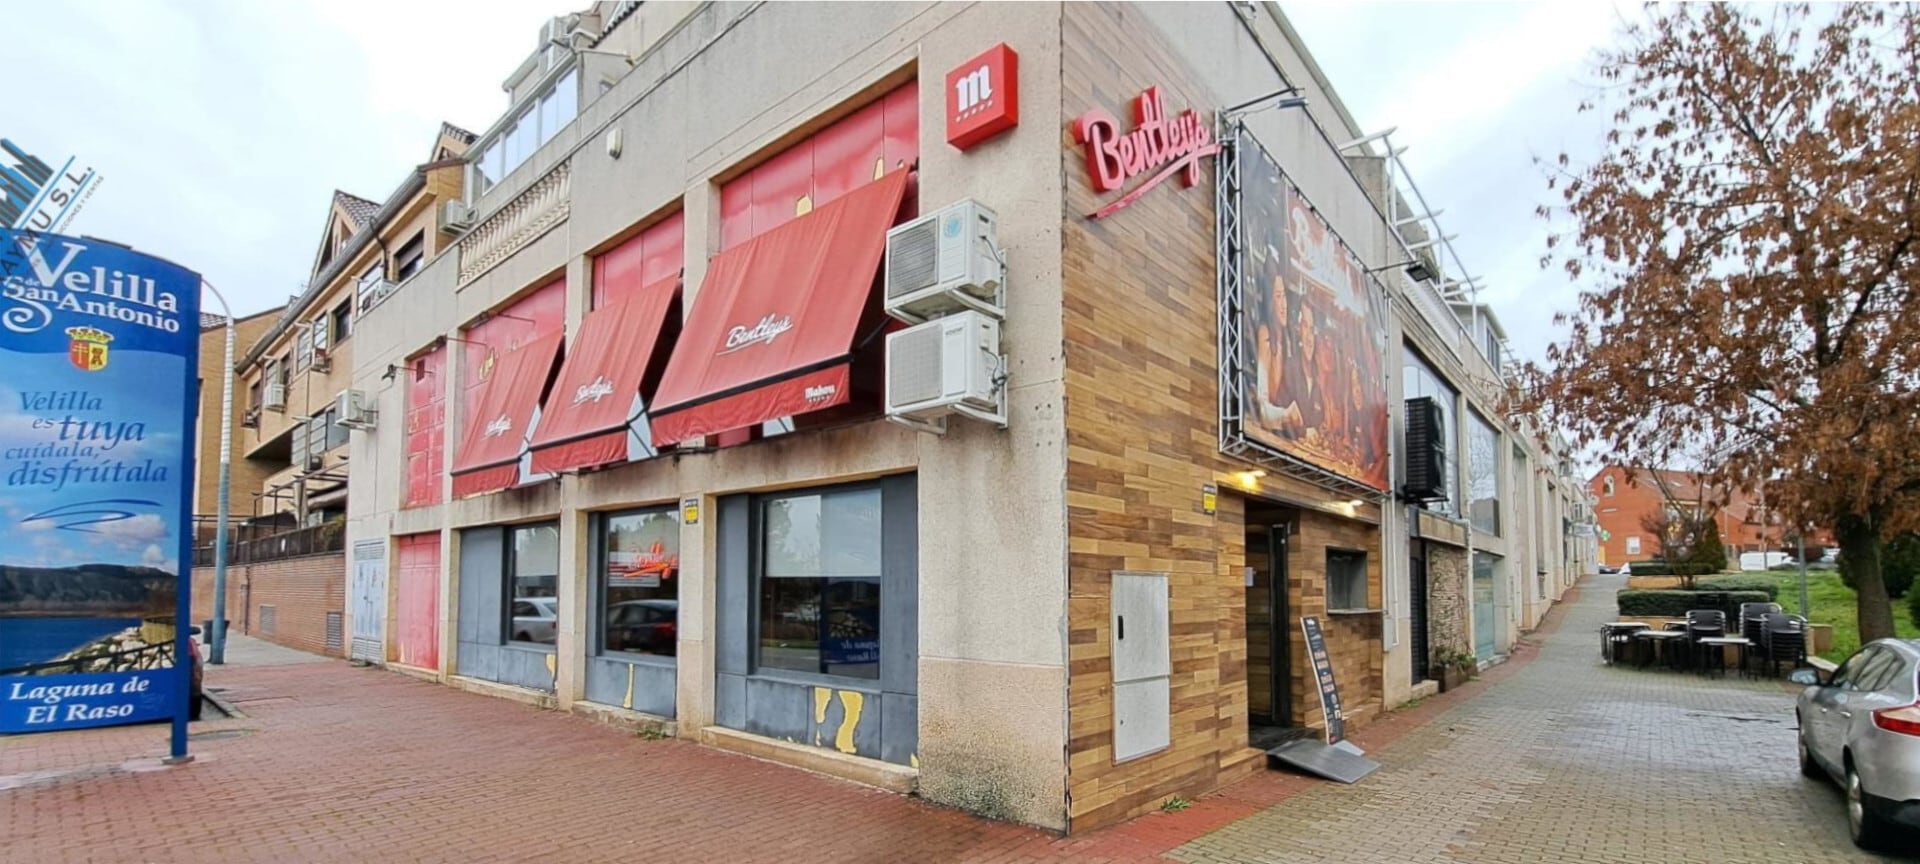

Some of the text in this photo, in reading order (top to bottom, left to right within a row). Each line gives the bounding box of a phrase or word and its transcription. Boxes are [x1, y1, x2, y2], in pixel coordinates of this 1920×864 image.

[13, 235, 179, 313] Velilla
[56, 295, 180, 333] Antonio
[20, 391, 103, 411] Velilla
[32, 415, 146, 451] es tuya
[5, 442, 101, 461] cuídala,
[8, 459, 168, 491] disfrútala
[10, 675, 149, 702] Laguna de
[26, 703, 134, 724] El Raso
